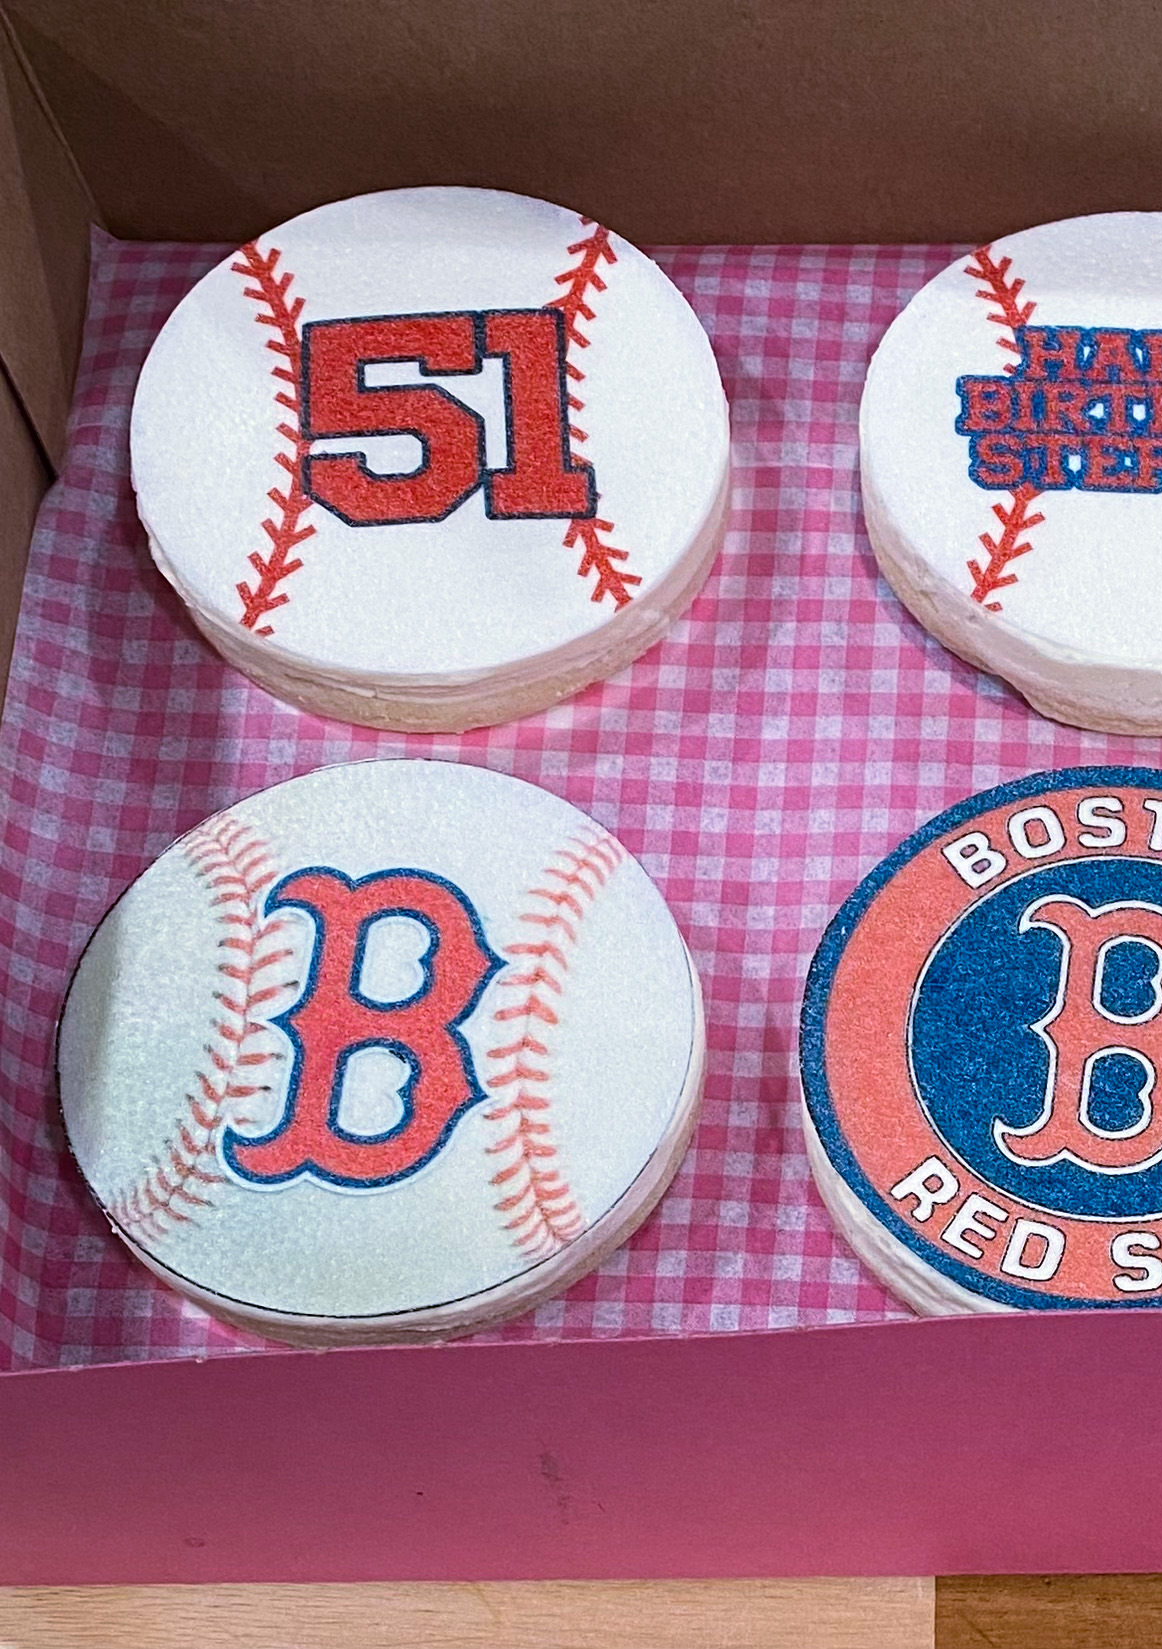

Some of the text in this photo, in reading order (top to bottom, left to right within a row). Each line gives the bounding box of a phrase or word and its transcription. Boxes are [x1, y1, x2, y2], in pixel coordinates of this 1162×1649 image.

[302, 307, 597, 527] 51
[222, 866, 508, 1188] B
[891, 1156, 1066, 1283] RED
